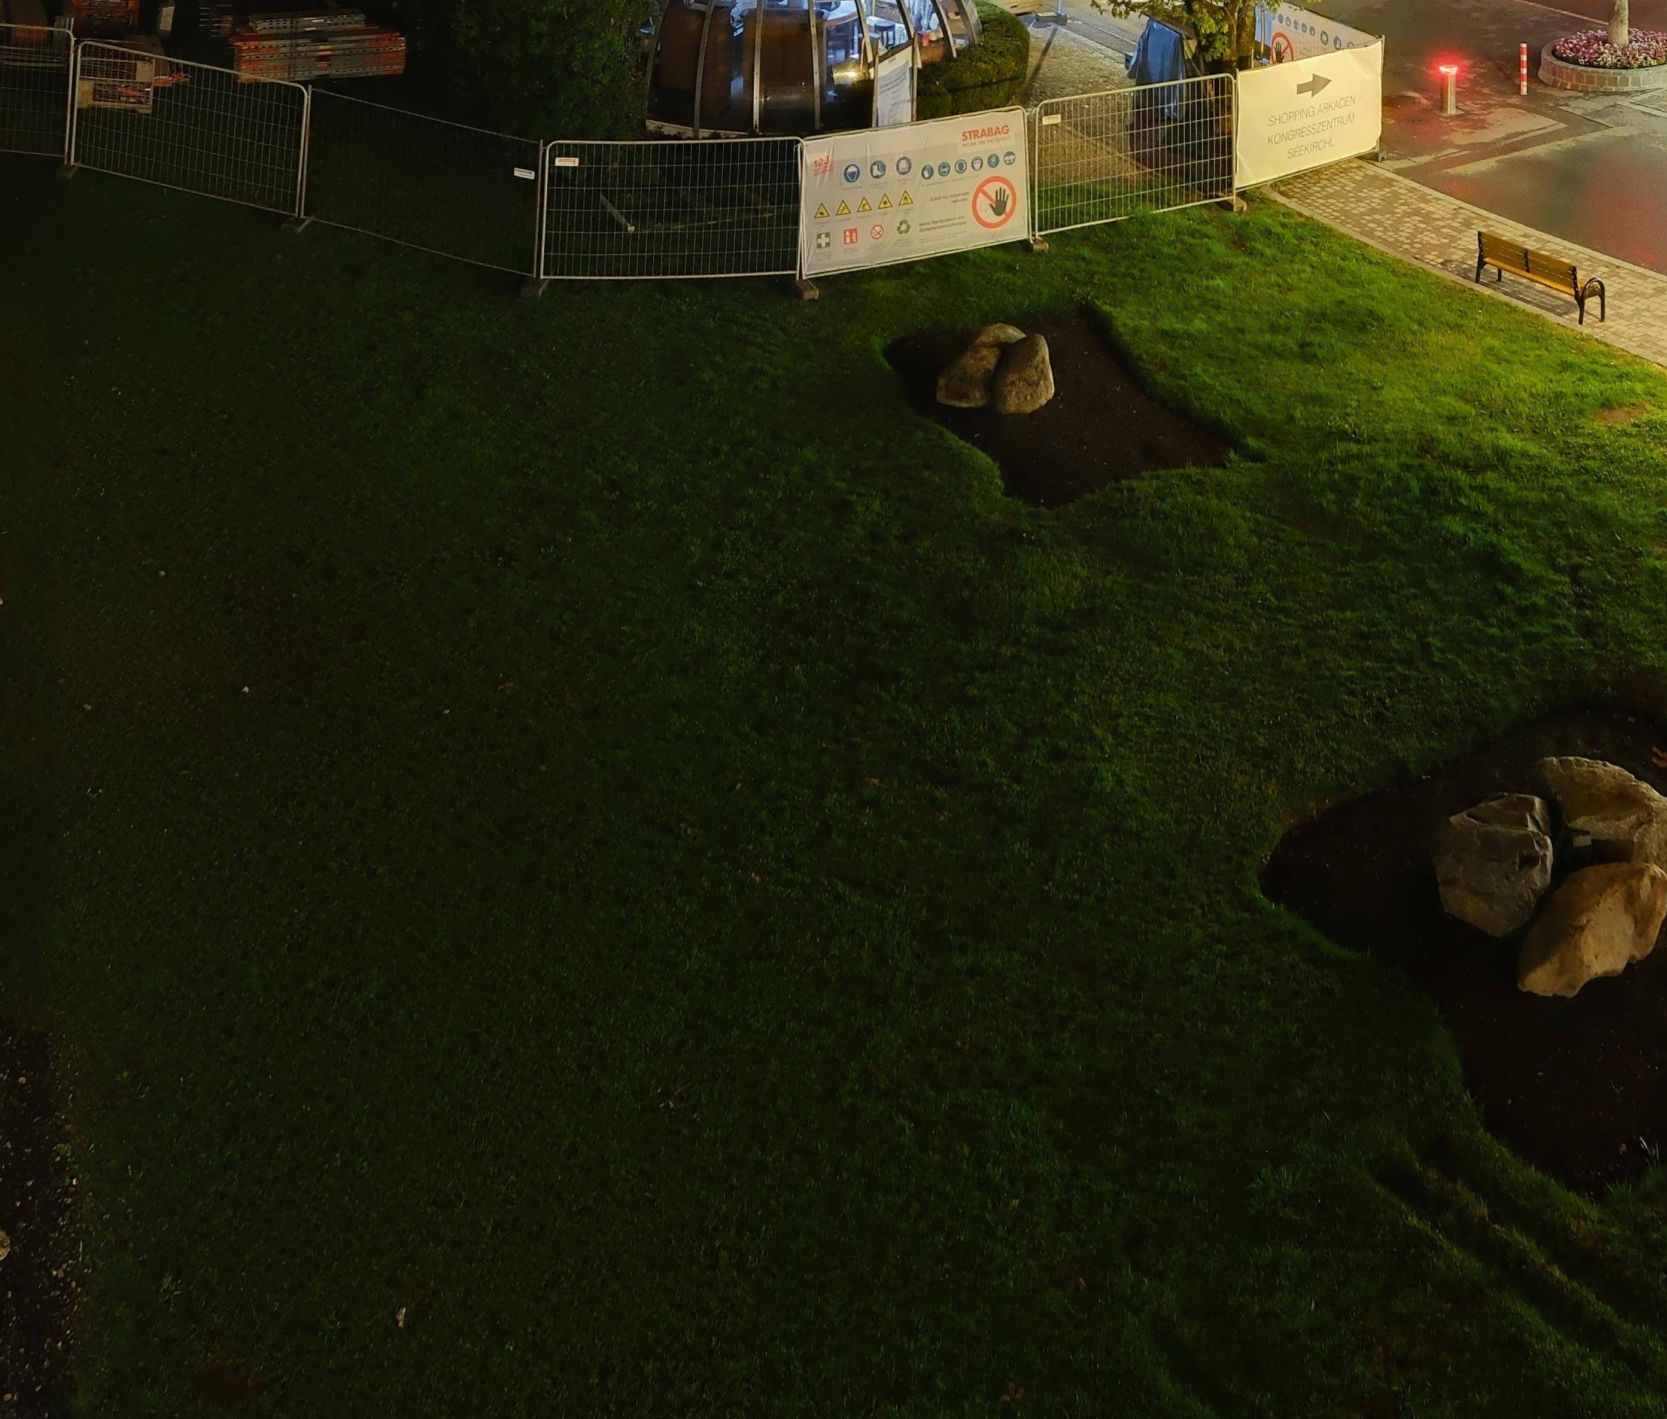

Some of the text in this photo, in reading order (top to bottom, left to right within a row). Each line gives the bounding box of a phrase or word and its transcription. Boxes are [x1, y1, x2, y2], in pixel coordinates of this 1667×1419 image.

[1267, 94, 1356, 128] SHOPPING ARKADEN
[961, 124, 1010, 142] STRABAG
[1267, 112, 1356, 146] KONGRESSZENTRUM
[1286, 140, 1335, 160] SEEKIRCHL
